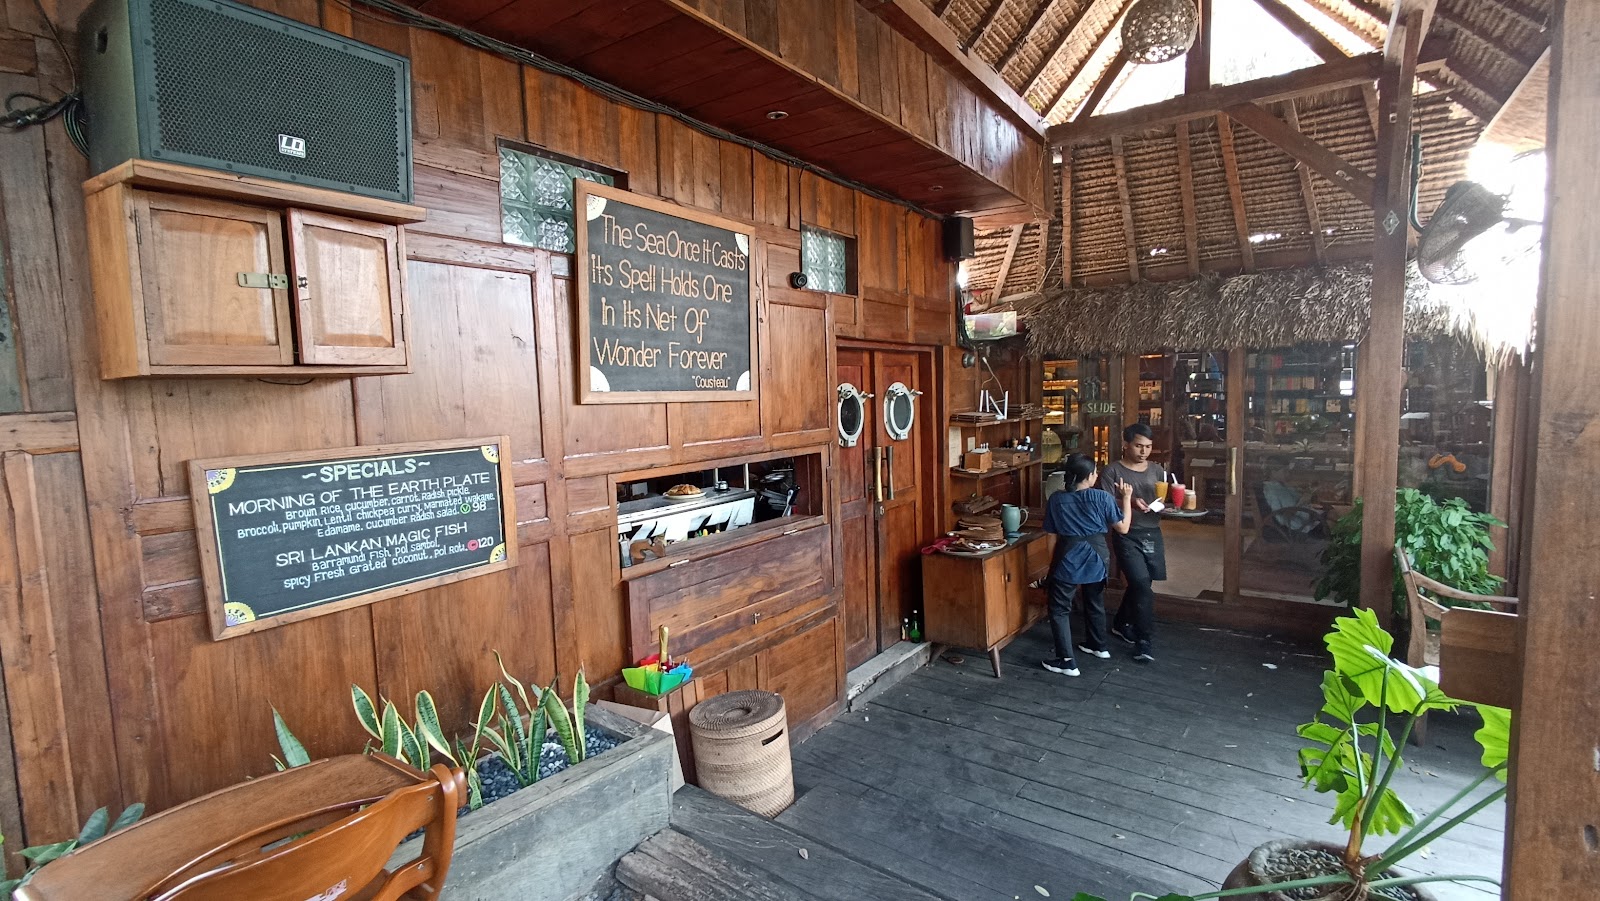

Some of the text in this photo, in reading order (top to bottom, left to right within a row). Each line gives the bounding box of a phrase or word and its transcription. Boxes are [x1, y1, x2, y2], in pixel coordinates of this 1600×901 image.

[600, 213, 633, 249] The
[635, 222, 666, 256] Sea
[666, 230, 700, 264] Once
[712, 241, 746, 272] Casts
[591, 253, 733, 303] Its Spell Holds One
[601, 296, 710, 345] In Its Net Of
[592, 336, 728, 370] Wonder Forever
[1087, 402, 1117, 414] SLIDE
[228, 471, 491, 516] MORNING OF THE EARTH PLATE
[285, 507, 318, 520] Brown
[421, 488, 445, 500] Radish
[324, 510, 353, 526] Lentil
[356, 507, 395, 520] chickpea
[365, 515, 408, 530] cucumber
[410, 509, 436, 523] Radish
[472, 500, 487, 513] 98
[276, 521, 468, 567] SRI LANKAN MAGIC FISH
[283, 574, 311, 590] spicy
[314, 565, 346, 582] Fresh
[349, 557, 388, 575] Grated
[434, 546, 447, 559] pol
[478, 536, 494, 549] 120
[312, 550, 367, 572] Barramundi
[395, 542, 408, 557] pol
